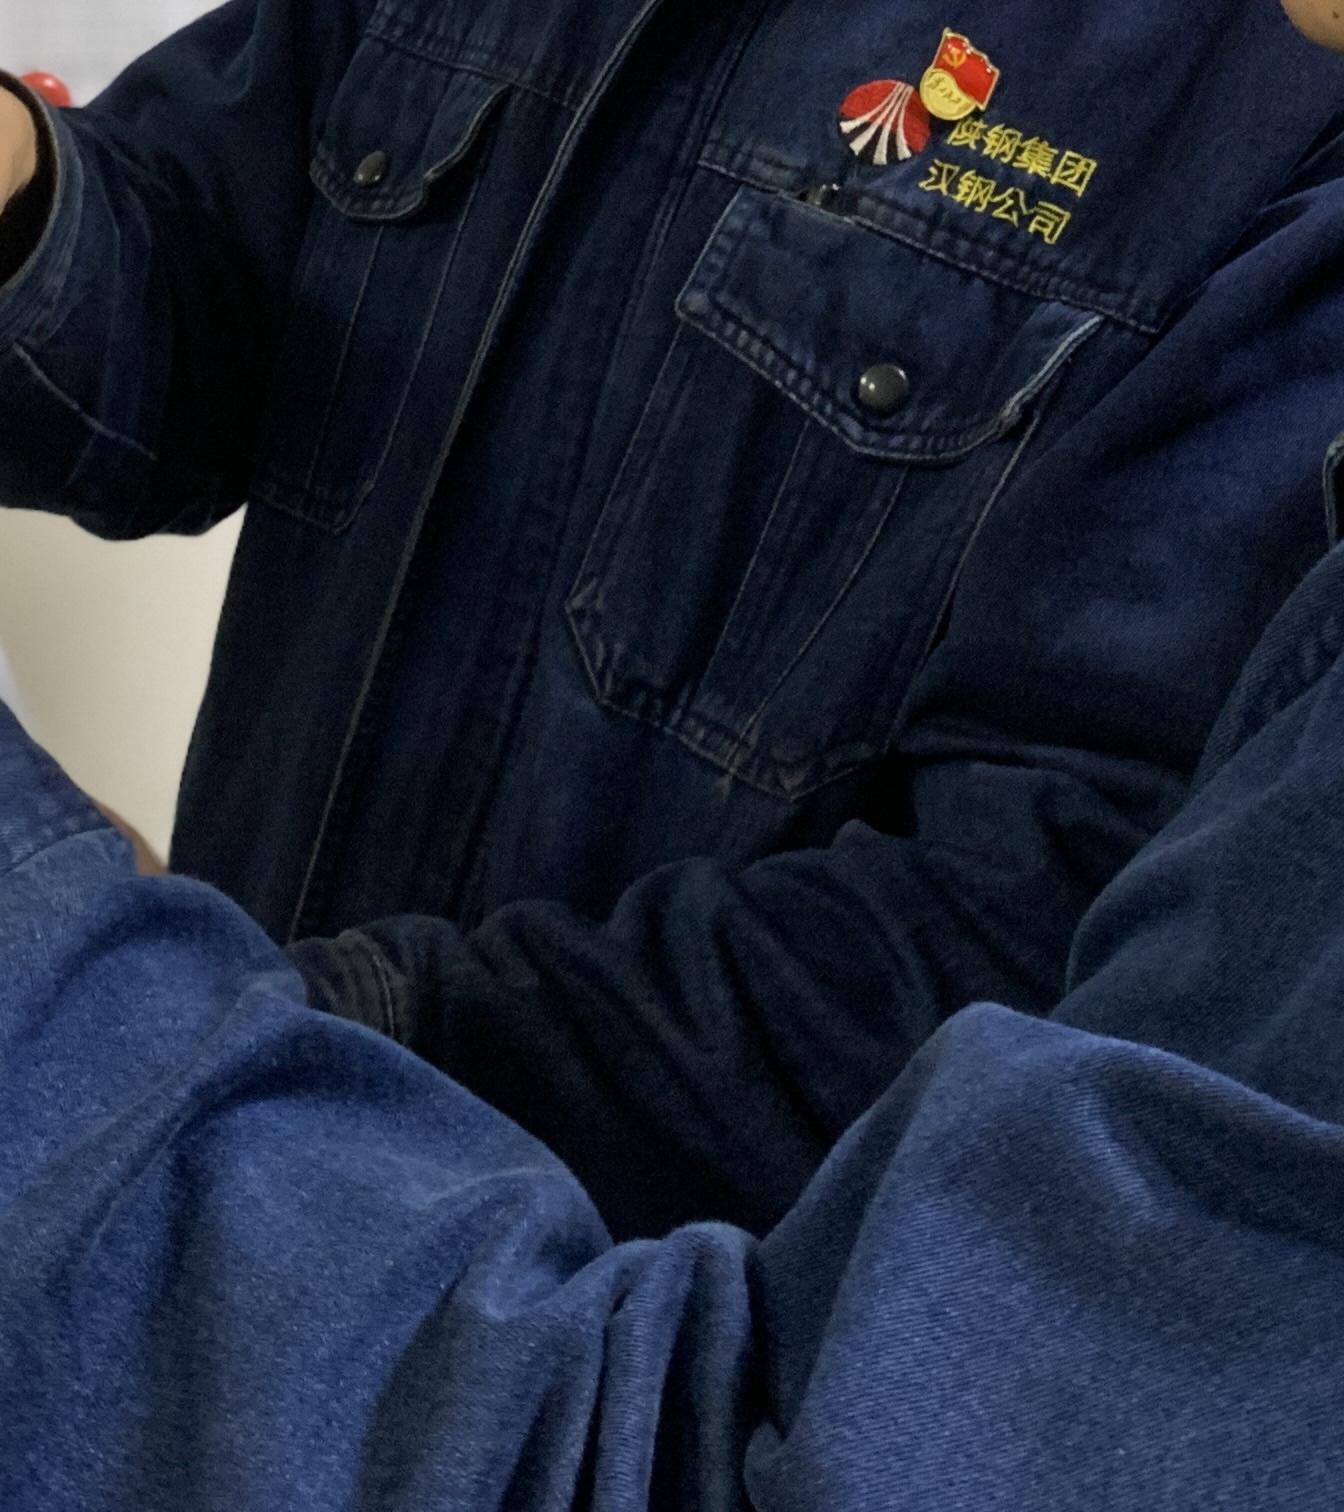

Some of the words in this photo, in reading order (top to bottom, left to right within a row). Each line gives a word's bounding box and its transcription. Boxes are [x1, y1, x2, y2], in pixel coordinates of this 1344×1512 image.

[946, 116, 1098, 198] 陕钢集团
[918, 158, 1072, 245] 汉钢公司
